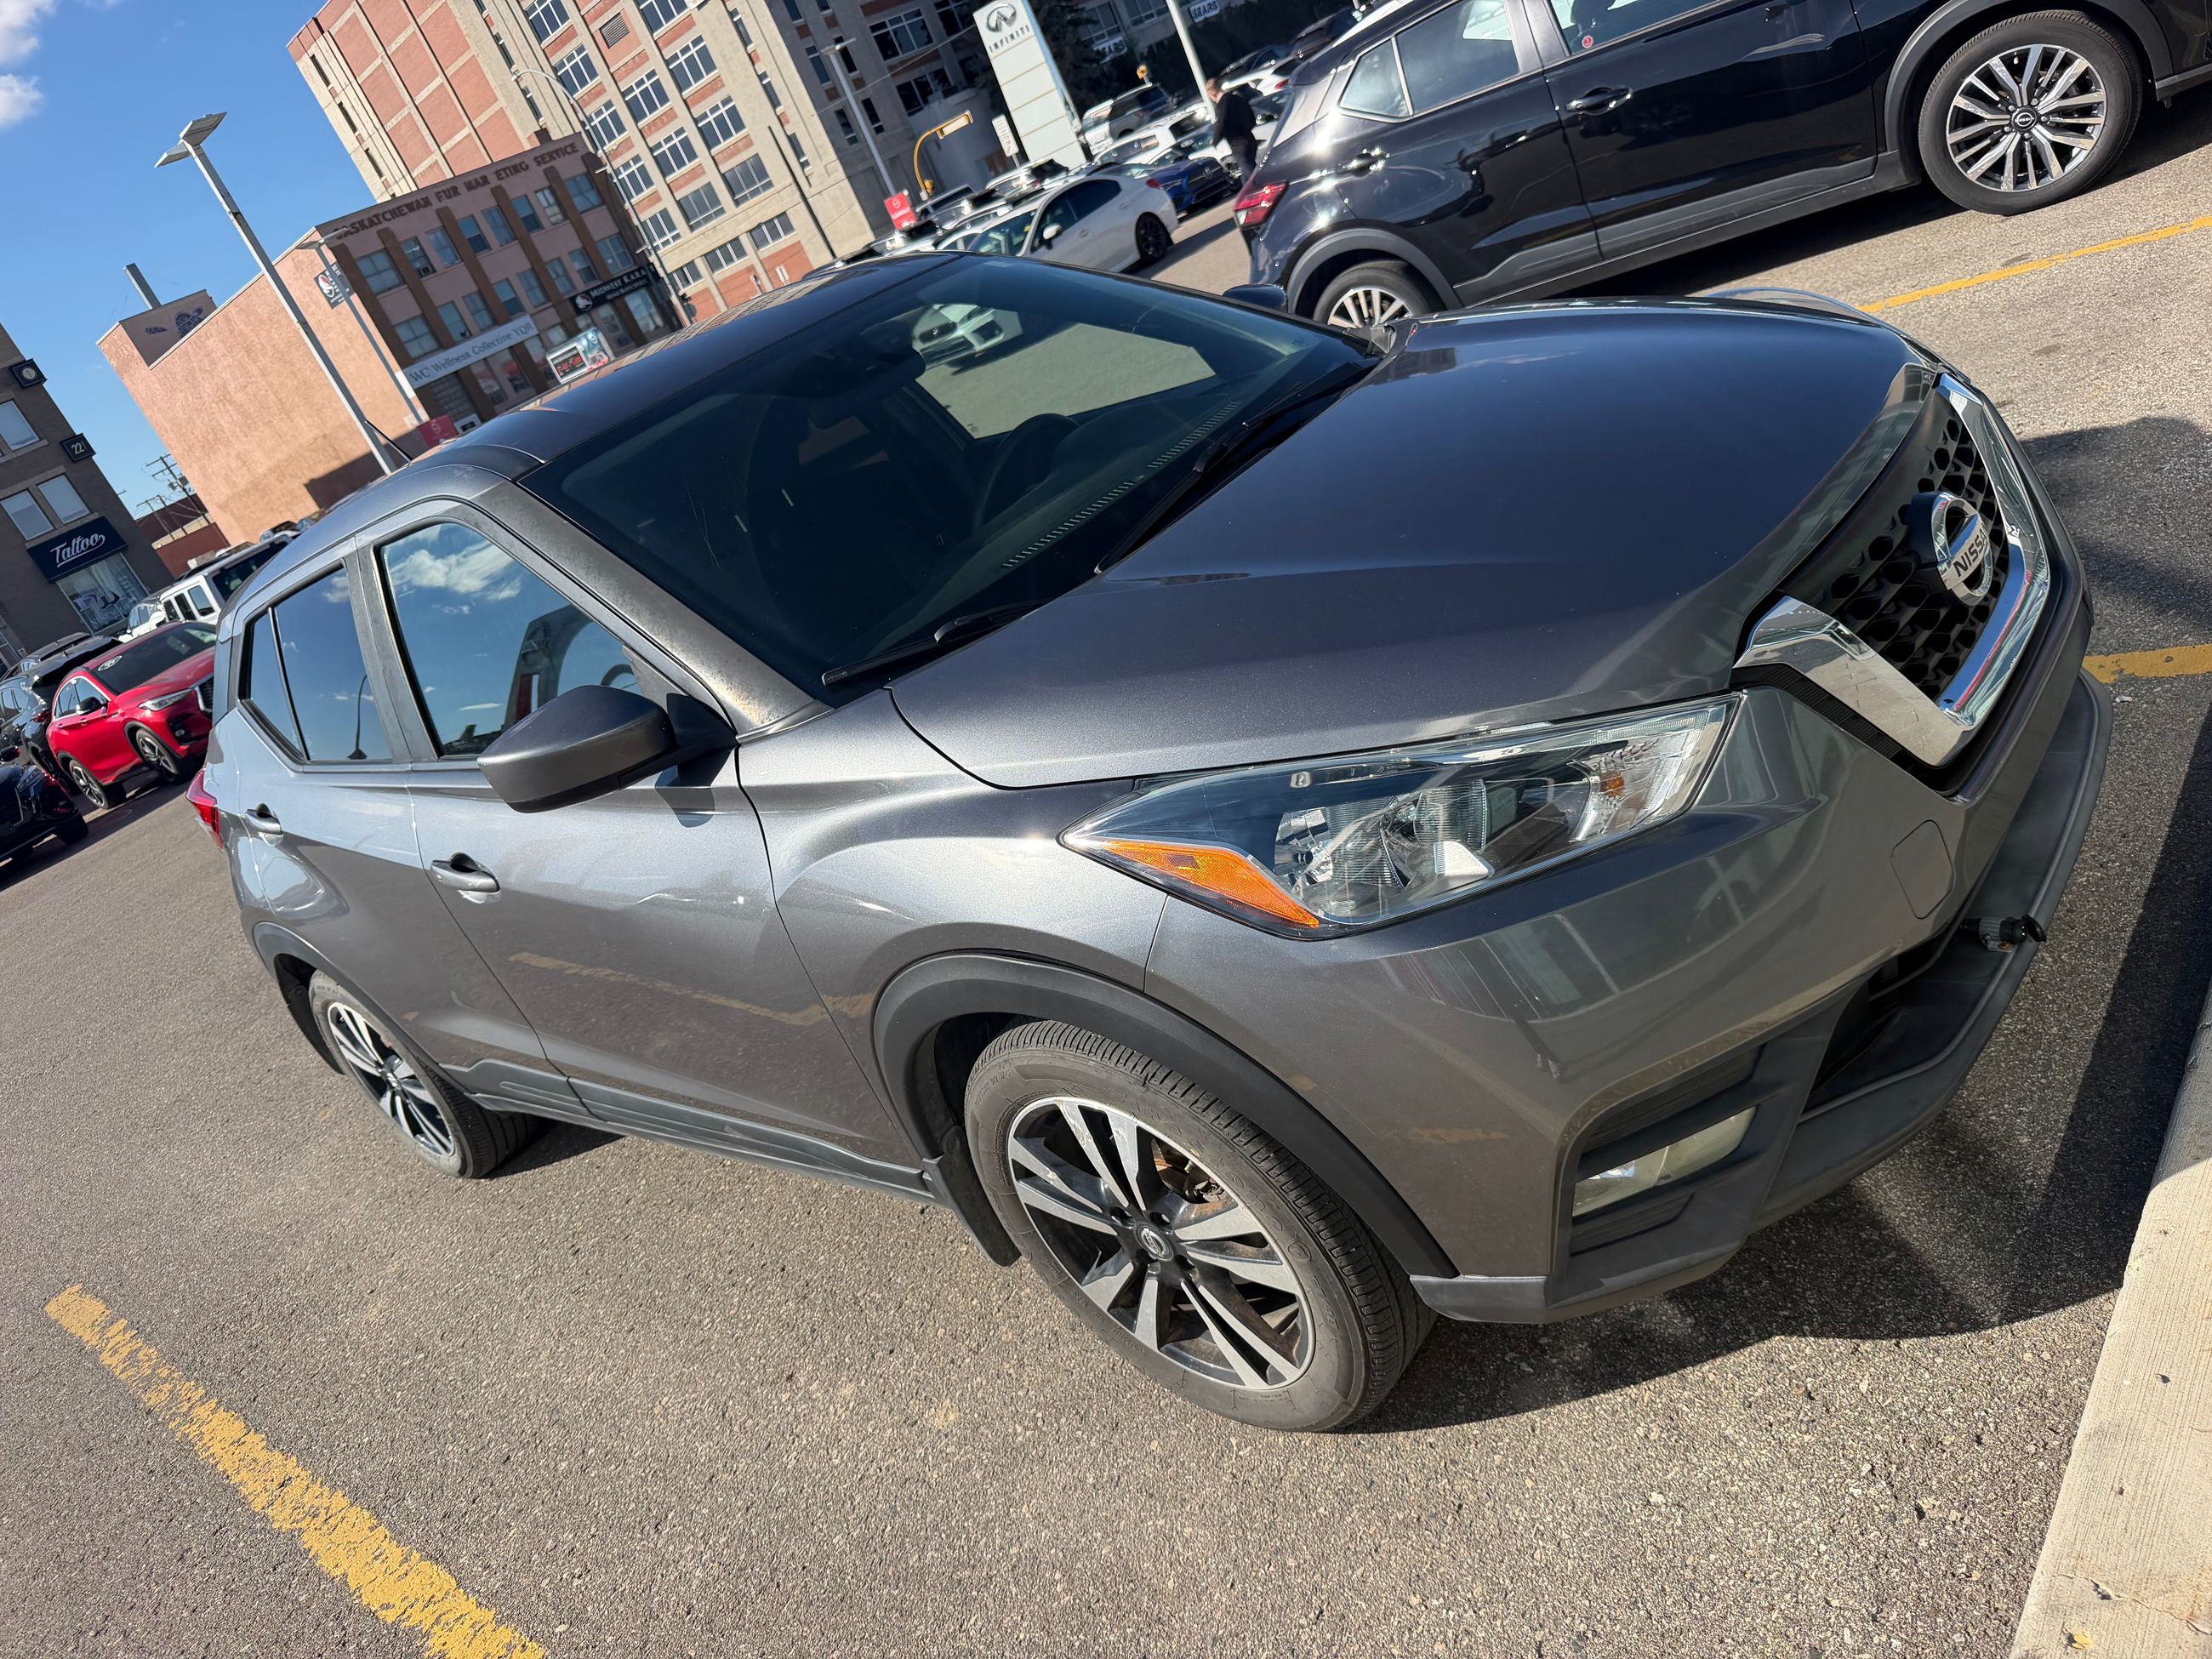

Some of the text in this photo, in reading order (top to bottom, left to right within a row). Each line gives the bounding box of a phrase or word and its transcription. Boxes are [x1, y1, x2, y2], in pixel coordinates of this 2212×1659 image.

[989, 24, 1029, 53] INFINITI
[435, 185, 461, 203] FUR
[533, 142, 579, 168] SERVICE
[431, 351, 472, 372] Wellness
[471, 333, 514, 356] Collective
[49, 533, 105, 568] Tattoo
